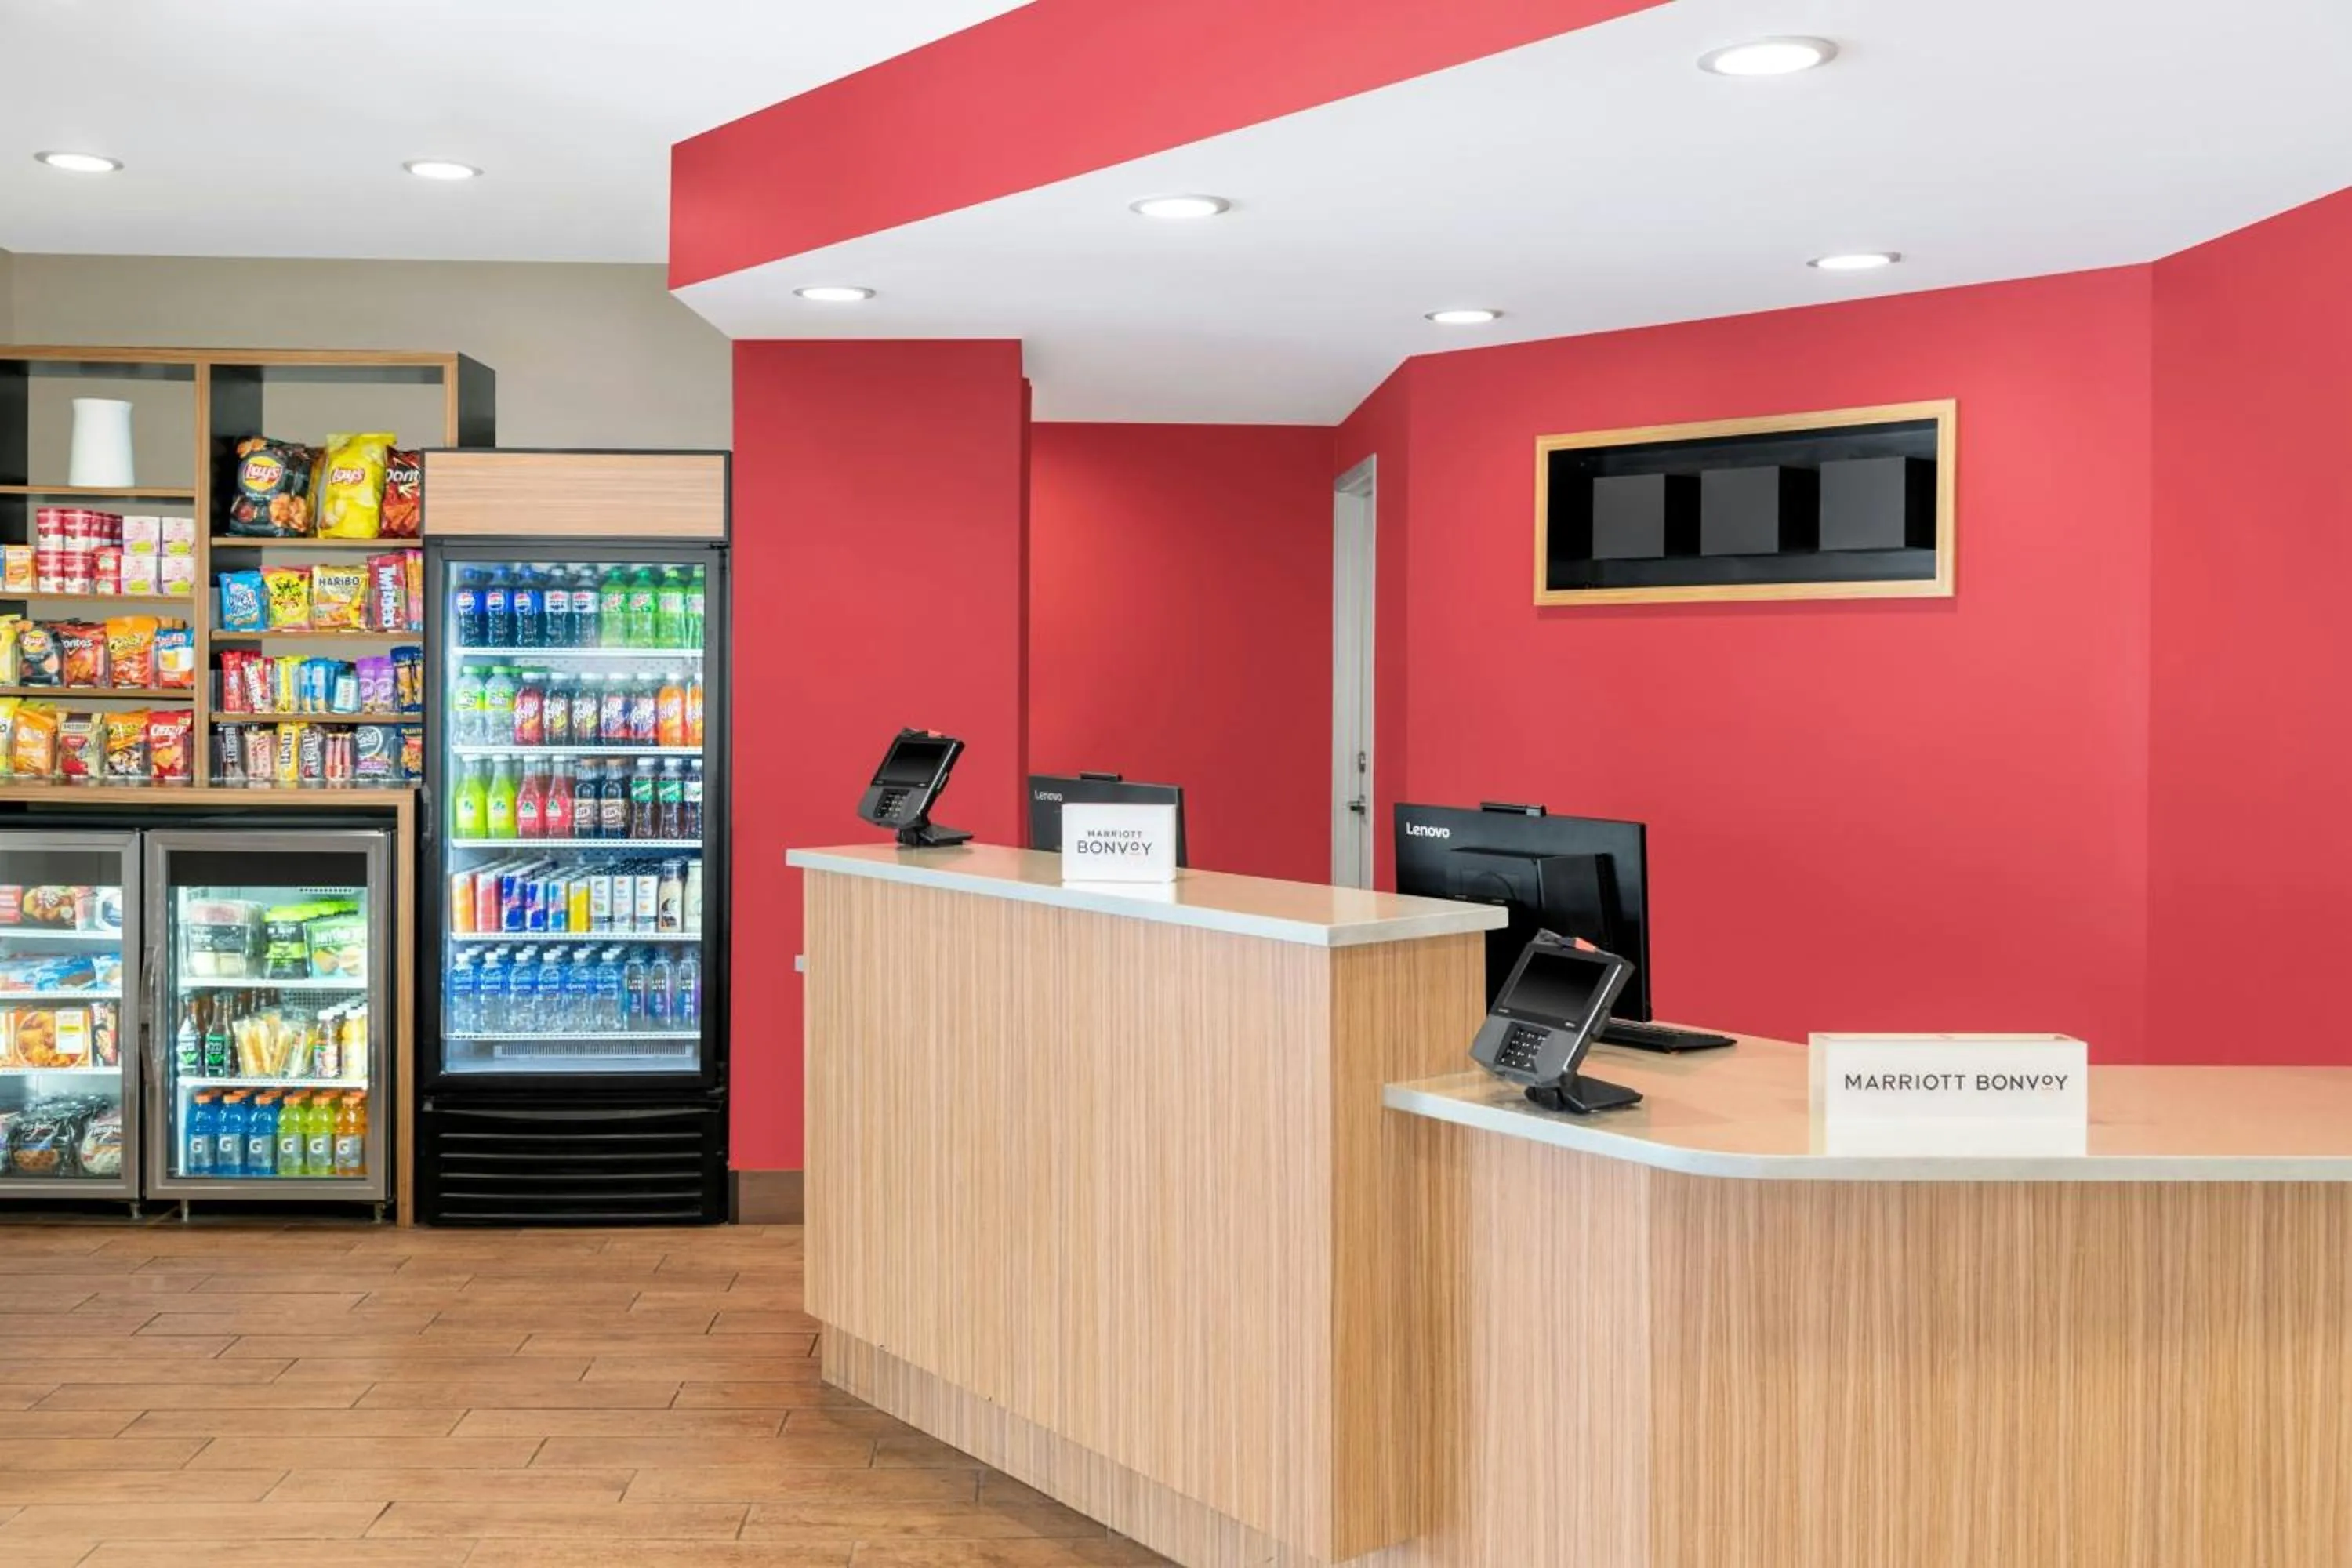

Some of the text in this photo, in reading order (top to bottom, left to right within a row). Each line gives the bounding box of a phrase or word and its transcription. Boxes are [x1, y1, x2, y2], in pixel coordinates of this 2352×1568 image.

[318, 576, 360, 586] HARIBO
[61, 638, 93, 648] oritos
[1034, 789, 1062, 802] Lenovo
[1406, 821, 1450, 839] Lenovo
[1077, 840, 1152, 856] BONVOY
[1845, 1074, 2068, 1091] MARRIOTT BONVOY
[191, 1138, 203, 1153] G
[219, 1137, 231, 1152] G
[250, 1139, 262, 1153] G
[281, 1138, 293, 1153] G
[310, 1139, 323, 1154] G
[337, 1139, 350, 1155] G
